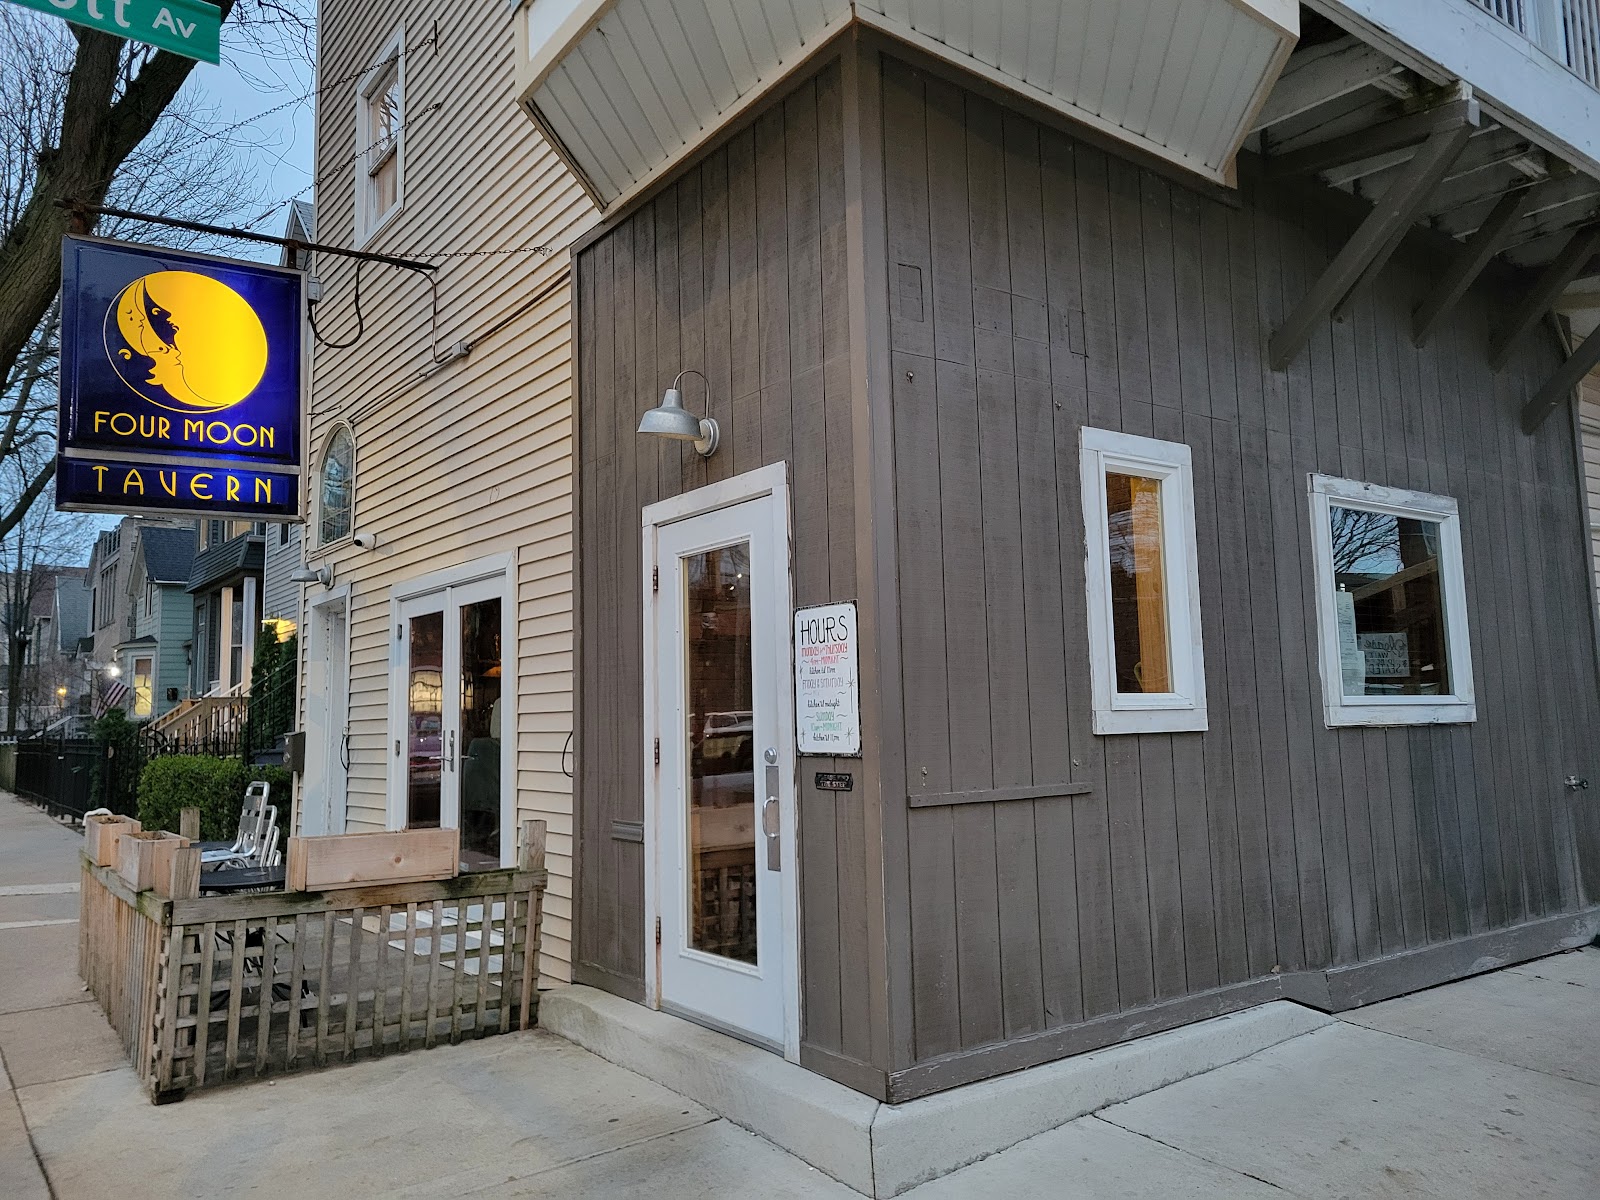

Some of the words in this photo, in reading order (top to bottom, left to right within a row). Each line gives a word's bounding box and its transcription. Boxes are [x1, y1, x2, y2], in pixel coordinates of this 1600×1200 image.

[152, 7, 197, 39] Av
[94, 411, 171, 440] FOUR
[184, 418, 275, 448] MOON
[92, 465, 272, 504] TAVERN
[800, 615, 848, 646] HOURS
